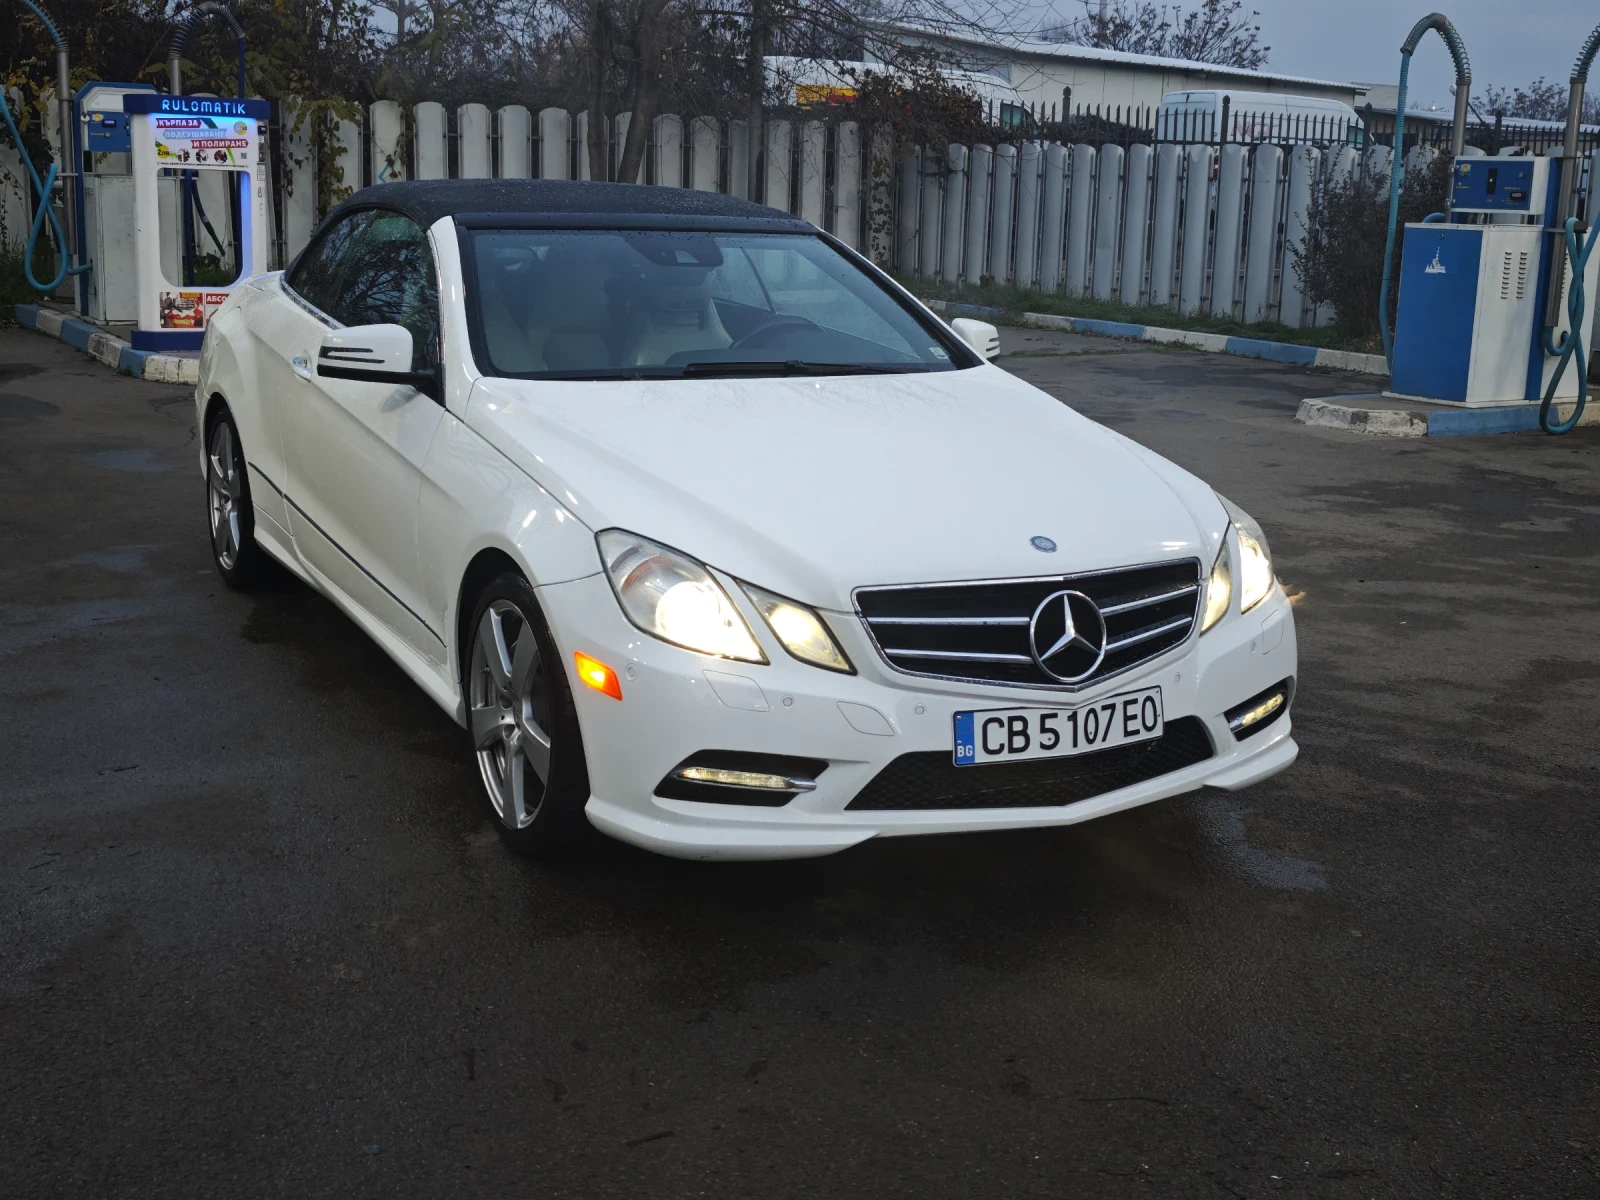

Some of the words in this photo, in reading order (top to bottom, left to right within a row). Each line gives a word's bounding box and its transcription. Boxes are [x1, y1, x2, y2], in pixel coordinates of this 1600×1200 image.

[162, 99, 246, 115] RULOMATIK
[982, 715, 1031, 755] CB
[1039, 702, 1117, 751] 5107
[957, 744, 973, 758] BG
